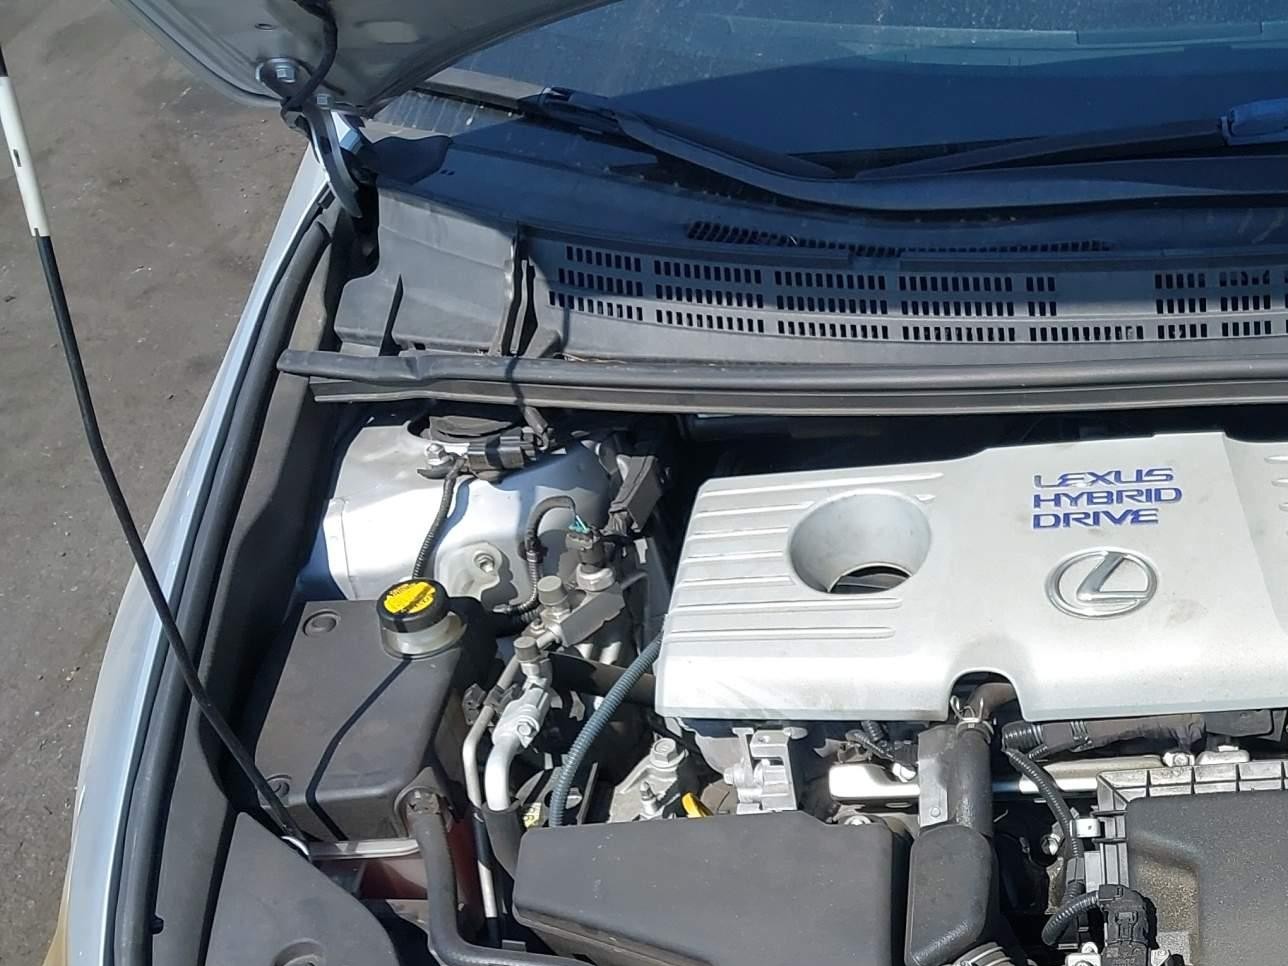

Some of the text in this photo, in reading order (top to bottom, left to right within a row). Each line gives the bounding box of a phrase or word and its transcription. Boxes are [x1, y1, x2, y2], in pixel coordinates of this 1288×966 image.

[1034, 467, 1174, 488] LEXUS
[1034, 488, 1182, 508] HYBRID
[1033, 508, 1159, 529] DRIVE
